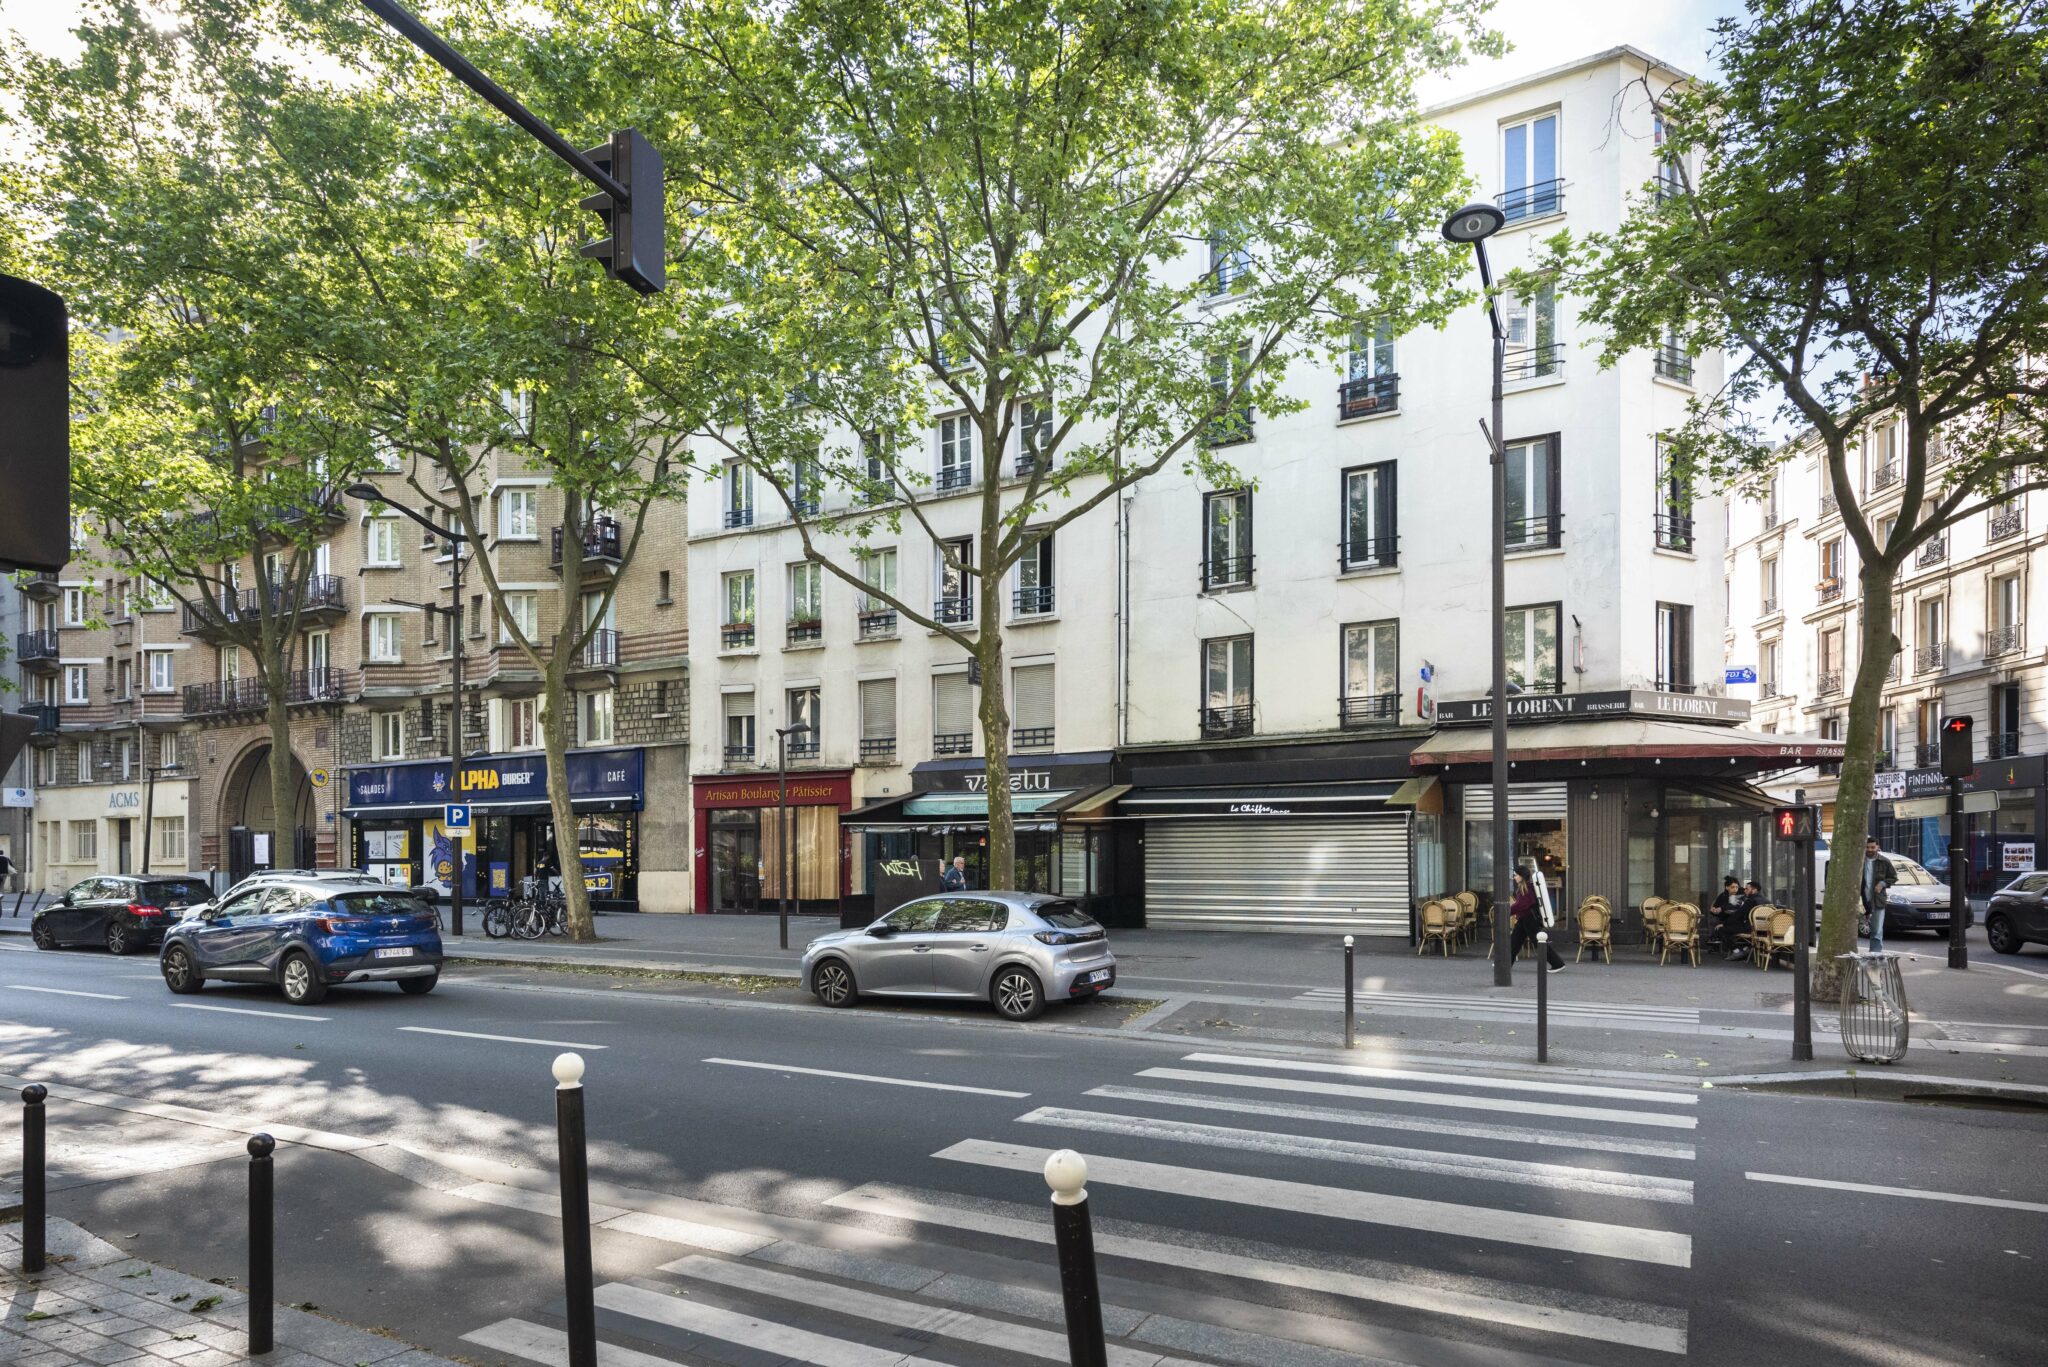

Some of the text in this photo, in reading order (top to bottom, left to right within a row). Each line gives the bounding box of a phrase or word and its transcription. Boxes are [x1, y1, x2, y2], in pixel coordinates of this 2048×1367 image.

[1472, 703, 1492, 717] LE
[1506, 698, 1576, 715] LORENT
[1586, 702, 1628, 711] BRASSERIE
[1657, 697, 1671, 711] LE
[1672, 699, 1718, 715] FLORENT
[1780, 746, 1846, 756] BAR BRASSE
[450, 770, 500, 790] LPHA
[607, 769, 625, 782] CAFÉ
[964, 769, 1051, 792] vastu
[360, 784, 385, 795] SALADES
[706, 785, 833, 801] Artisan Boulangr Pâtissier
[109, 791, 140, 809] ACMS
[452, 808, 464, 823] P
[1231, 804, 1239, 812] Le
[1240, 804, 1270, 815] Chiffre
